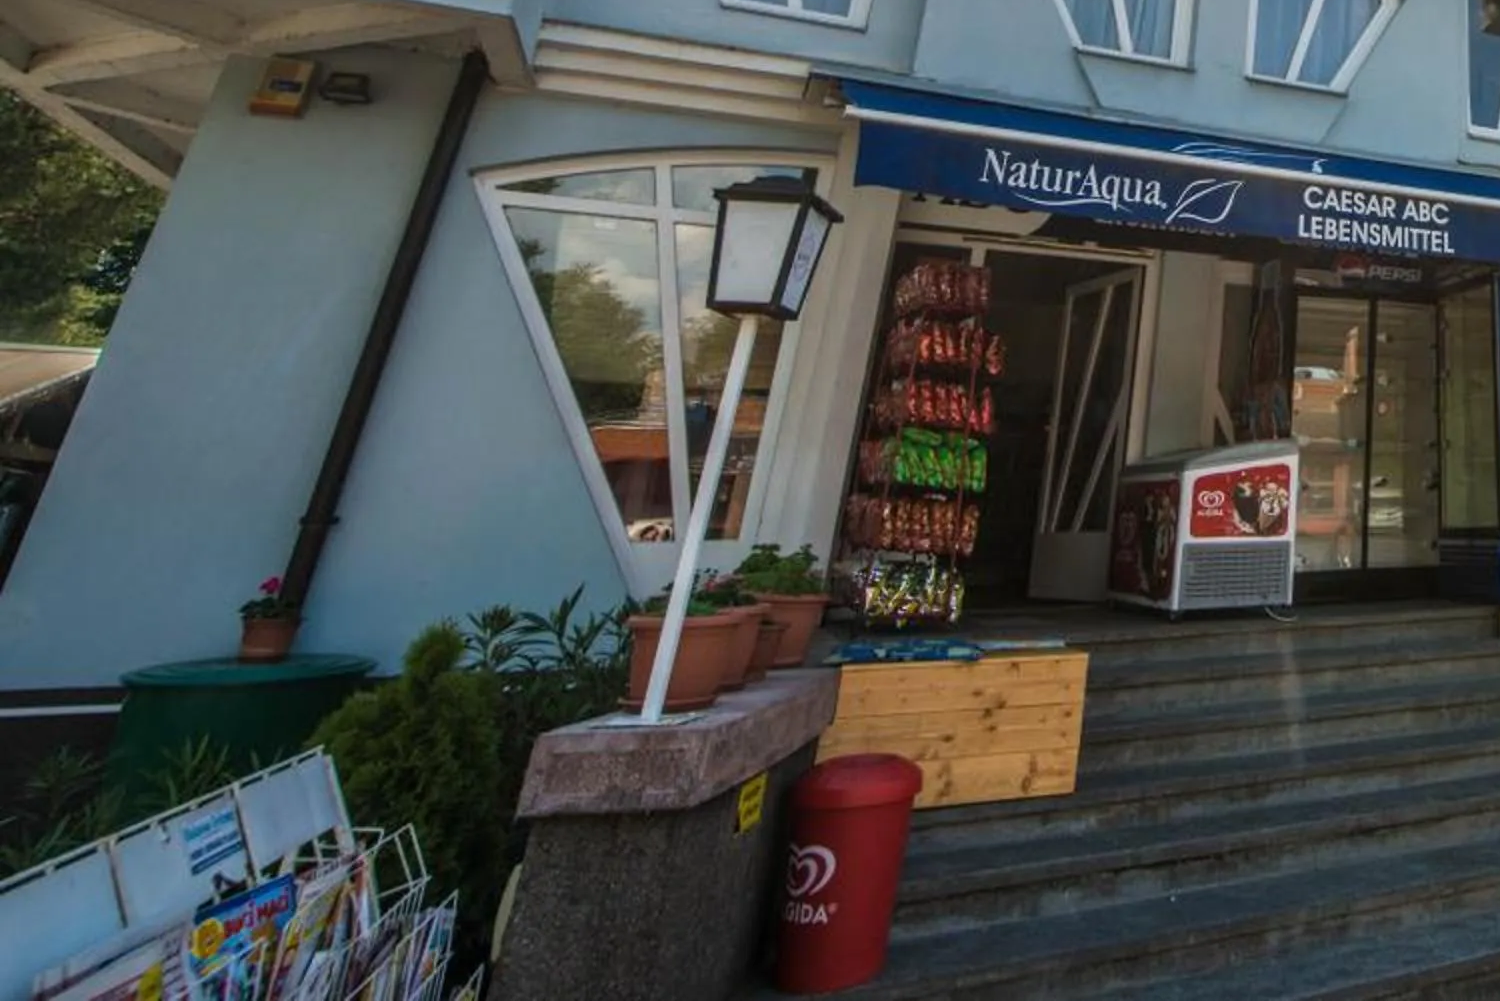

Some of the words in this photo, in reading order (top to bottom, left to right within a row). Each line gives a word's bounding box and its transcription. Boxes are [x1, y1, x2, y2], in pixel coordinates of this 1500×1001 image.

[979, 148, 1162, 210] NaturAqua
[1303, 185, 1396, 218] CAESAR
[1403, 200, 1450, 225] ABC
[1298, 215, 1455, 255] LEBENSMITTEL
[1368, 264, 1423, 282] PEPSI
